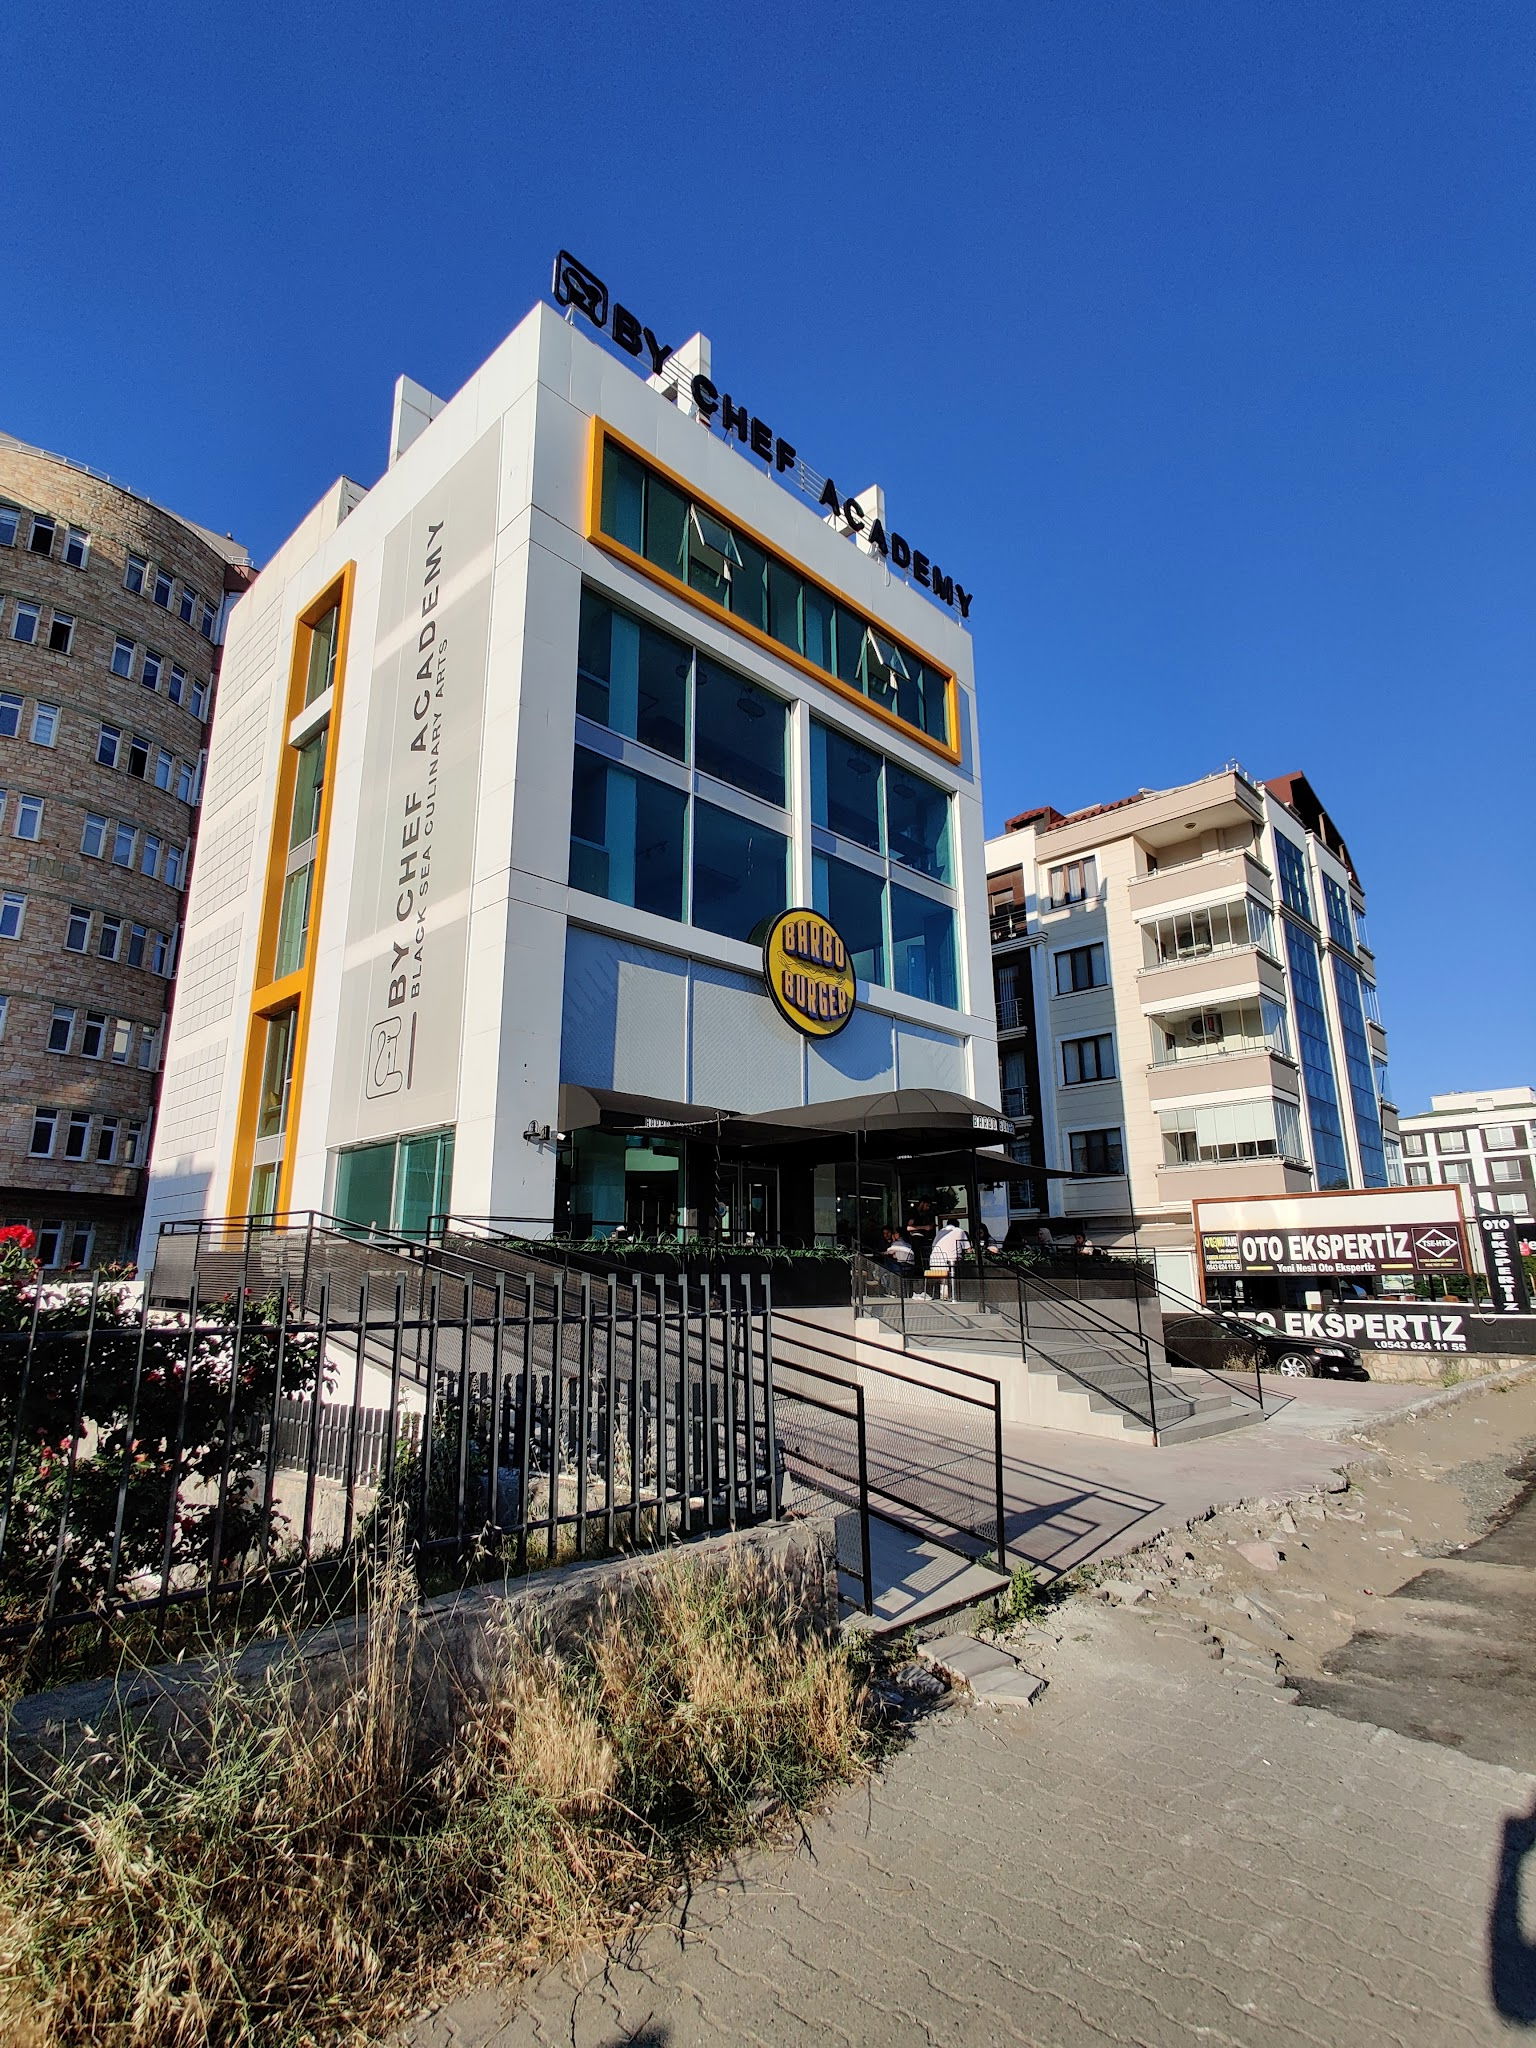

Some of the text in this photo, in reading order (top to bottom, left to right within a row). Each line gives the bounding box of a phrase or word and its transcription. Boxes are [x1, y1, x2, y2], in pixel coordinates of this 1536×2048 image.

[612, 303, 973, 619] BY CHEF ACADEMY
[388, 520, 444, 1008] BY CHEF ACADEMY
[410, 638, 448, 998] BLACK SEA CULINARY ARTS
[783, 920, 846, 971] BARBO
[782, 970, 848, 1020] BURGER
[1242, 1225, 1412, 1262] OTO EKSPERTİZ
[1482, 1219, 1510, 1230] OTO
[1277, 1262, 1376, 1274] Yeni Nesil Oto Ekspertiz
[1380, 1340, 1467, 1351] 0543 624 11 55
